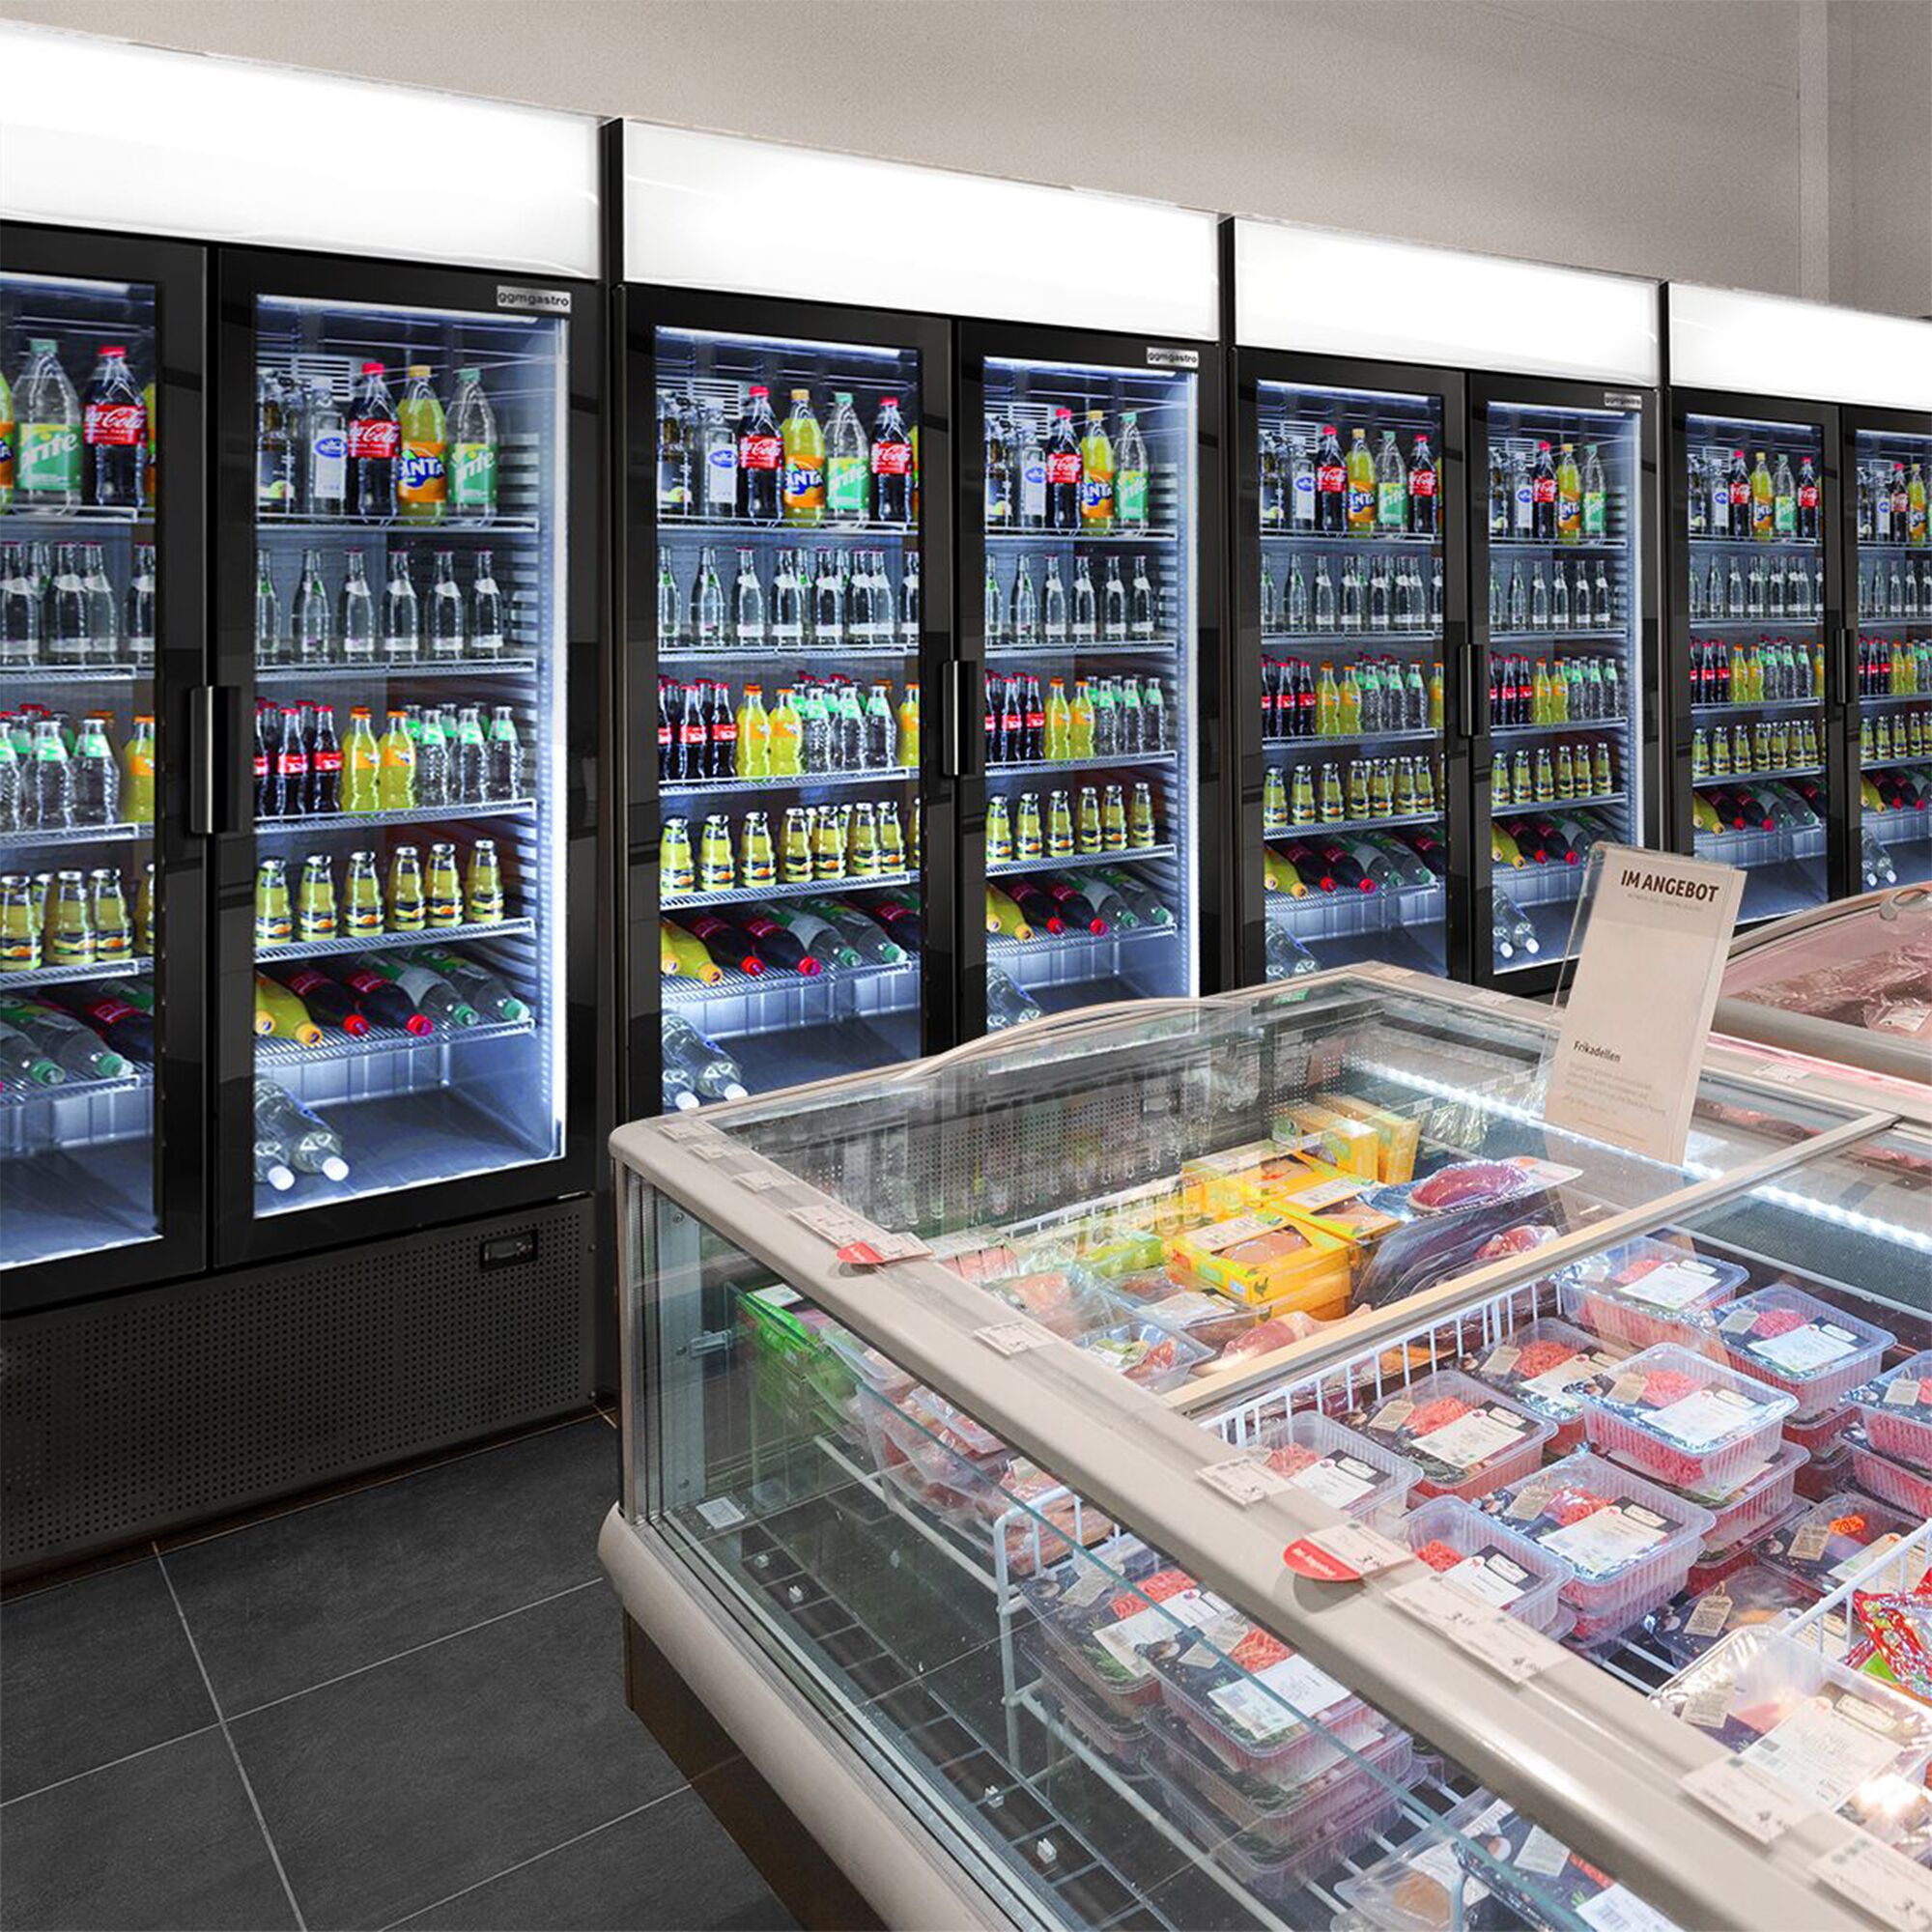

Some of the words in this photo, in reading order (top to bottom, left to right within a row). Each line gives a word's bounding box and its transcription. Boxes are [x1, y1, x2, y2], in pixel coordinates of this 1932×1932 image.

[497, 292, 570, 307] ggmgastro
[1621, 869, 1641, 888] IM
[1641, 873, 1719, 902] ANGEBOT
[1573, 1040, 1622, 1064] Frikadellen
